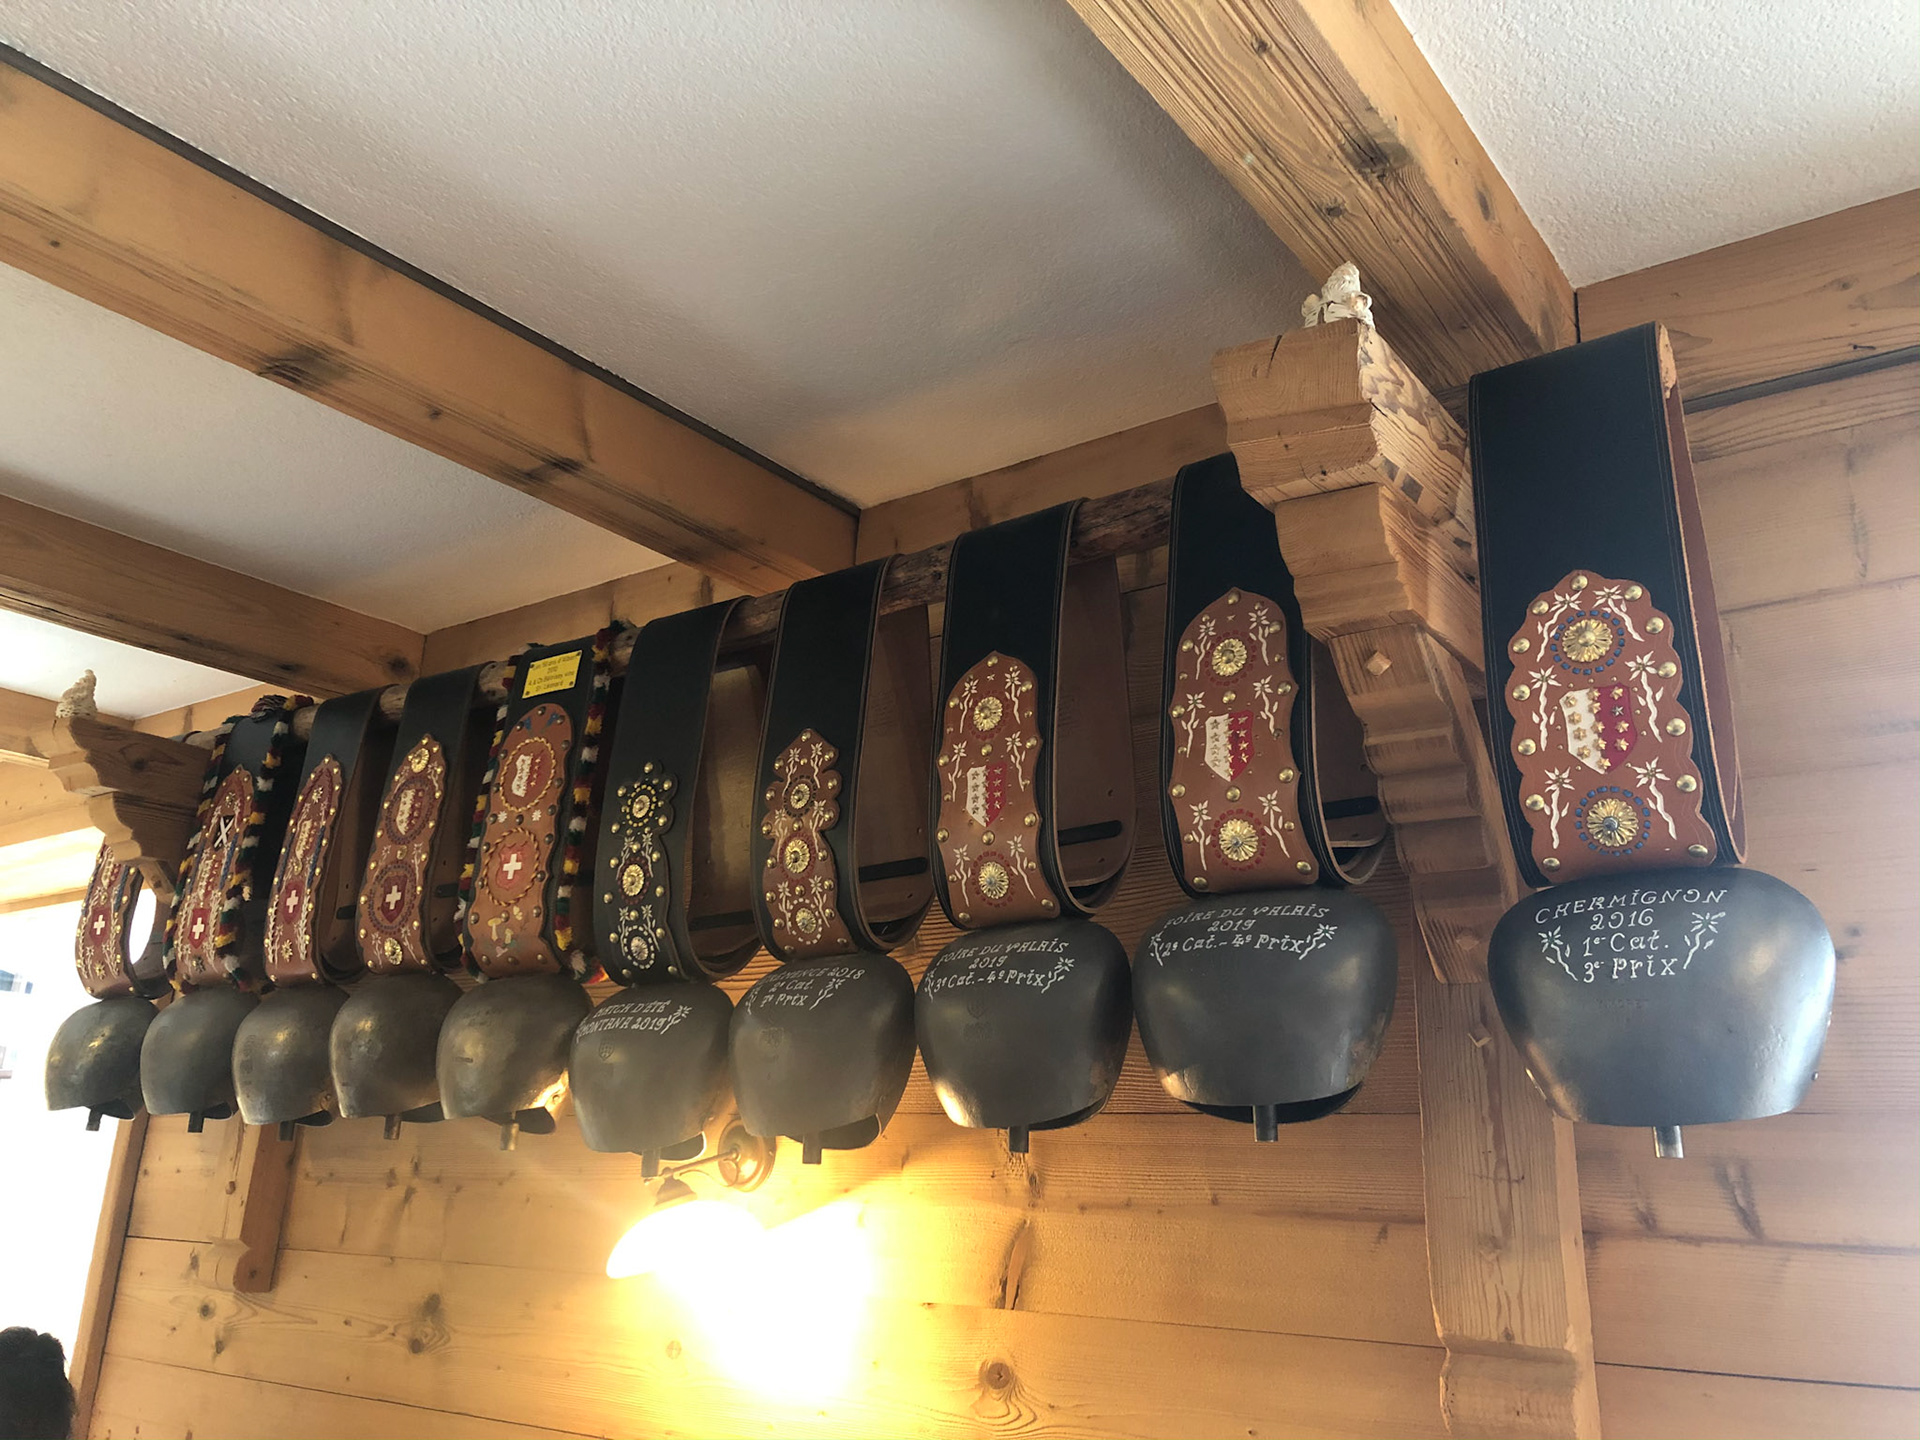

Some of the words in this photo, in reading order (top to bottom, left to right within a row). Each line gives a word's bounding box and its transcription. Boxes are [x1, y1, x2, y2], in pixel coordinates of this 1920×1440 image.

[1163, 909, 1216, 929] FOIRE
[1217, 907, 1248, 919] DU
[1252, 903, 1331, 918] VALAIS
[1534, 888, 1728, 925] CHERMIGNON
[1207, 919, 1257, 932] 2019
[1589, 908, 1655, 931] 2016
[1253, 933, 1305, 954] Prix
[1610, 929, 1670, 953] Cat.
[936, 946, 981, 967] FOIRE
[979, 944, 1004, 956] DU
[1005, 937, 1070, 954] VALAIS
[968, 955, 1008, 970] 2019
[827, 966, 866, 980] 2018
[1612, 954, 1678, 980] Prix
[1004, 969, 1046, 987] Prix
[775, 993, 809, 1006] Prix
[631, 1016, 667, 1031] 2019
